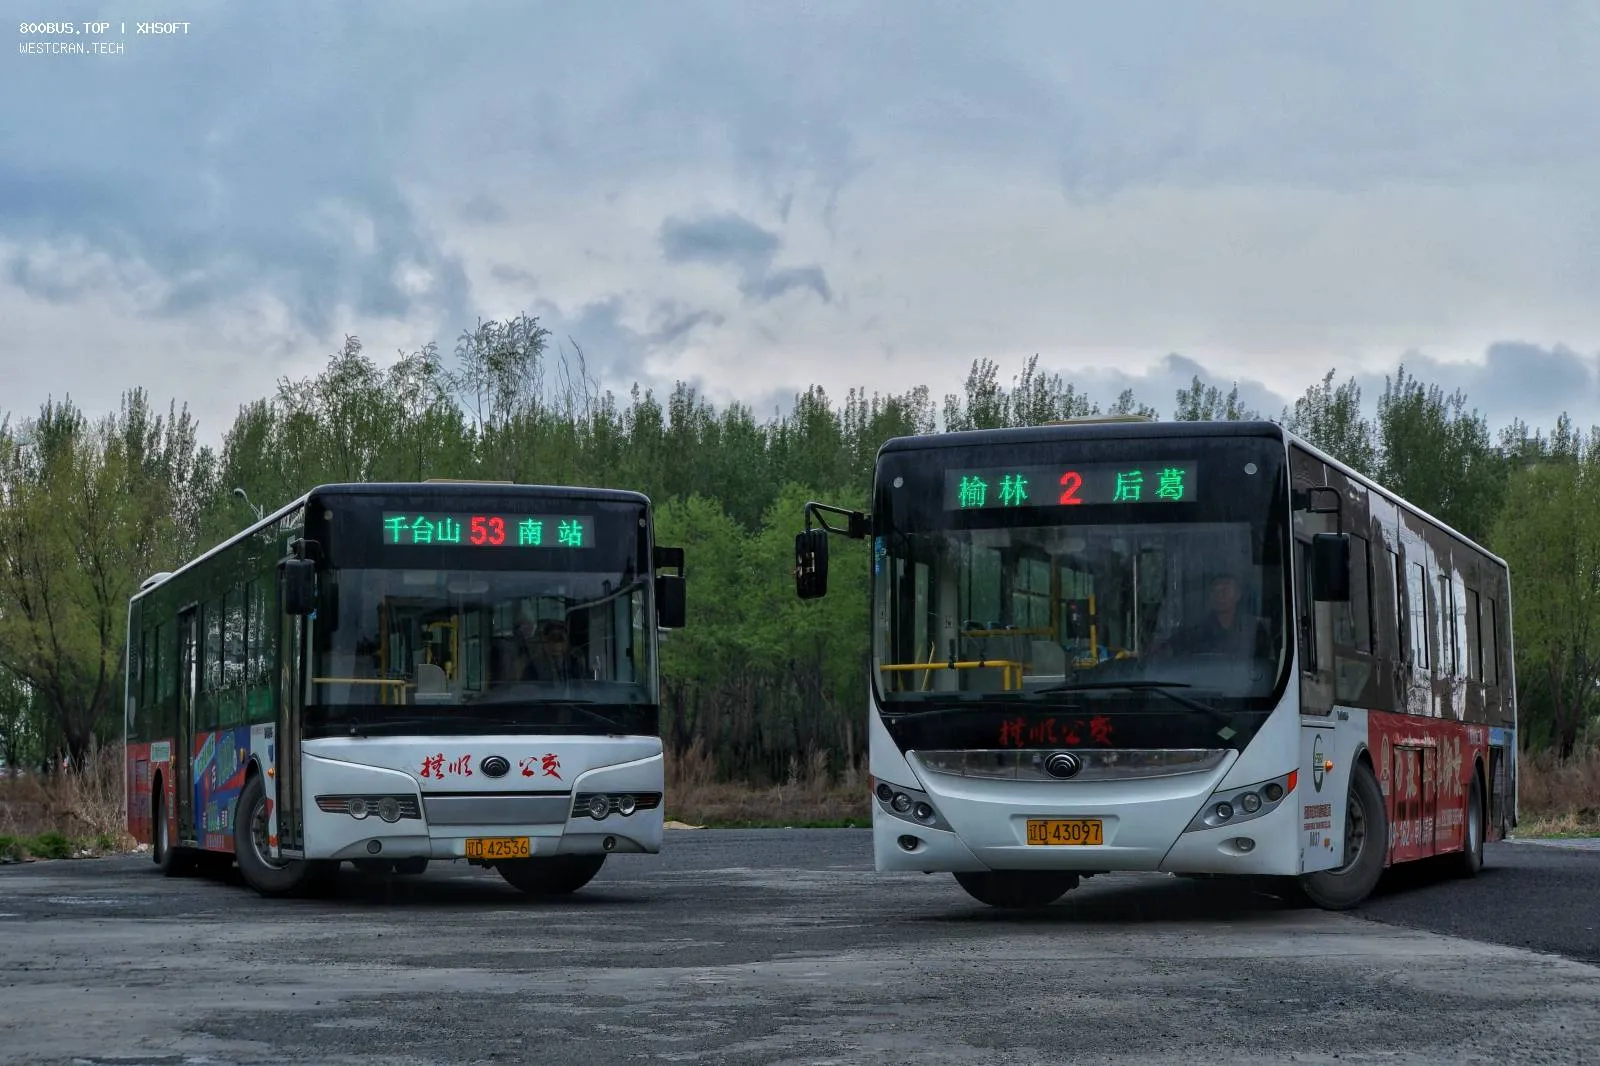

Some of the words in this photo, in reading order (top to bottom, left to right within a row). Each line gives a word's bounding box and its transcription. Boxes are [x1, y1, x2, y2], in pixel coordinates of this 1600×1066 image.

[958, 474, 1028, 508] 榆林
[1059, 471, 1083, 505] 2
[1113, 468, 1185, 502] 后葛
[384, 516, 461, 543] 千台山
[470, 516, 505, 545] 53
[518, 518, 584, 546] 南站
